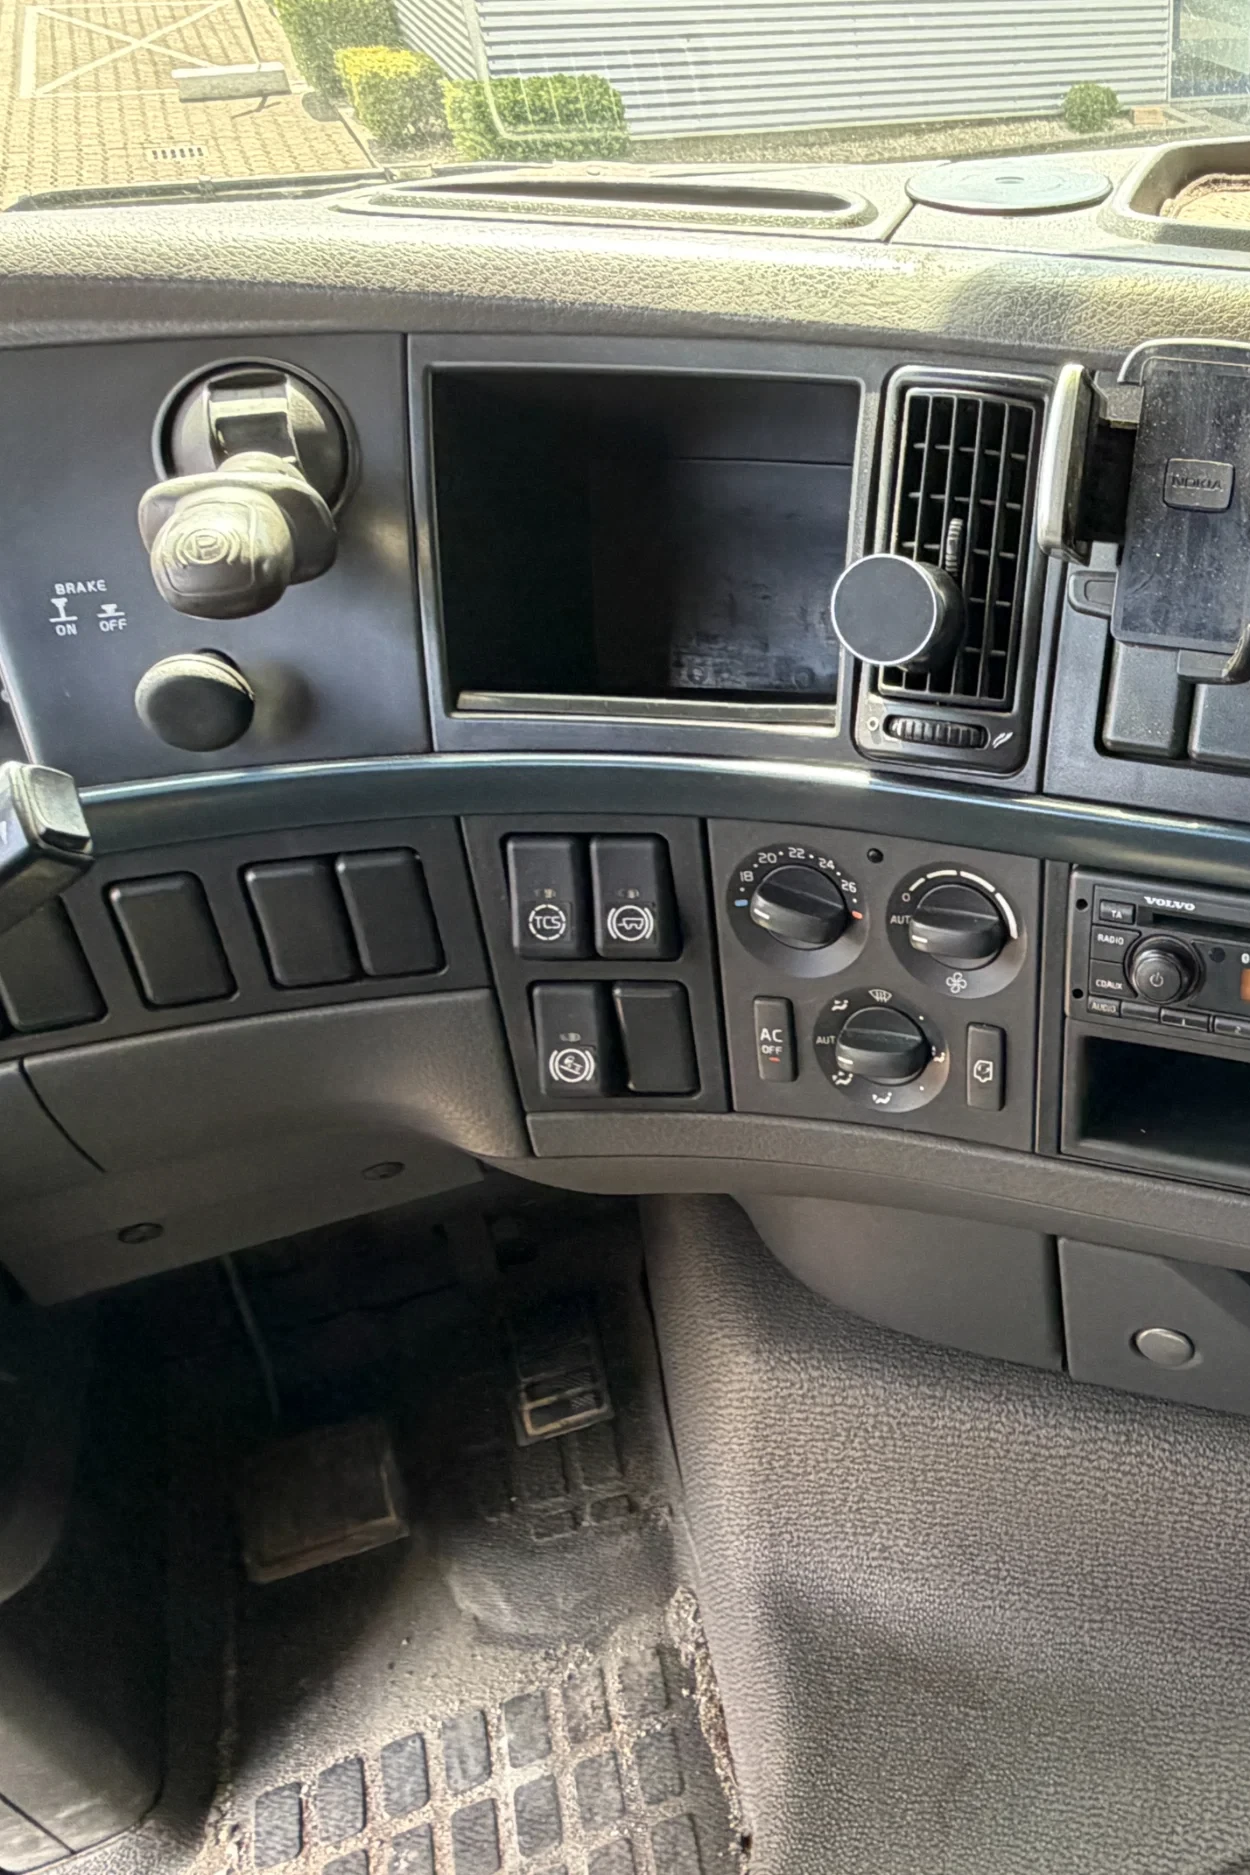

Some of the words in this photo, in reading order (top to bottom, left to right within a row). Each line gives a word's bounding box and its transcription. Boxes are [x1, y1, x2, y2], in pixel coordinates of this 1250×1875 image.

[1171, 475, 1223, 491] NOKIA
[54, 579, 107, 596] BRAKE
[55, 624, 77, 636] ON
[99, 618, 127, 632] OFF
[758, 852, 777, 863] 20
[788, 847, 806, 859] 22
[818, 857, 835, 870] 24
[740, 870, 754, 882] 18
[841, 879, 857, 893] 26
[1143, 896, 1196, 911] VOLVO
[1111, 910, 1122, 919] TA
[534, 915, 562, 930] TCS
[1097, 933, 1124, 945] RADIO
[760, 1027, 784, 1043] AC
[761, 1044, 783, 1055] OFF
